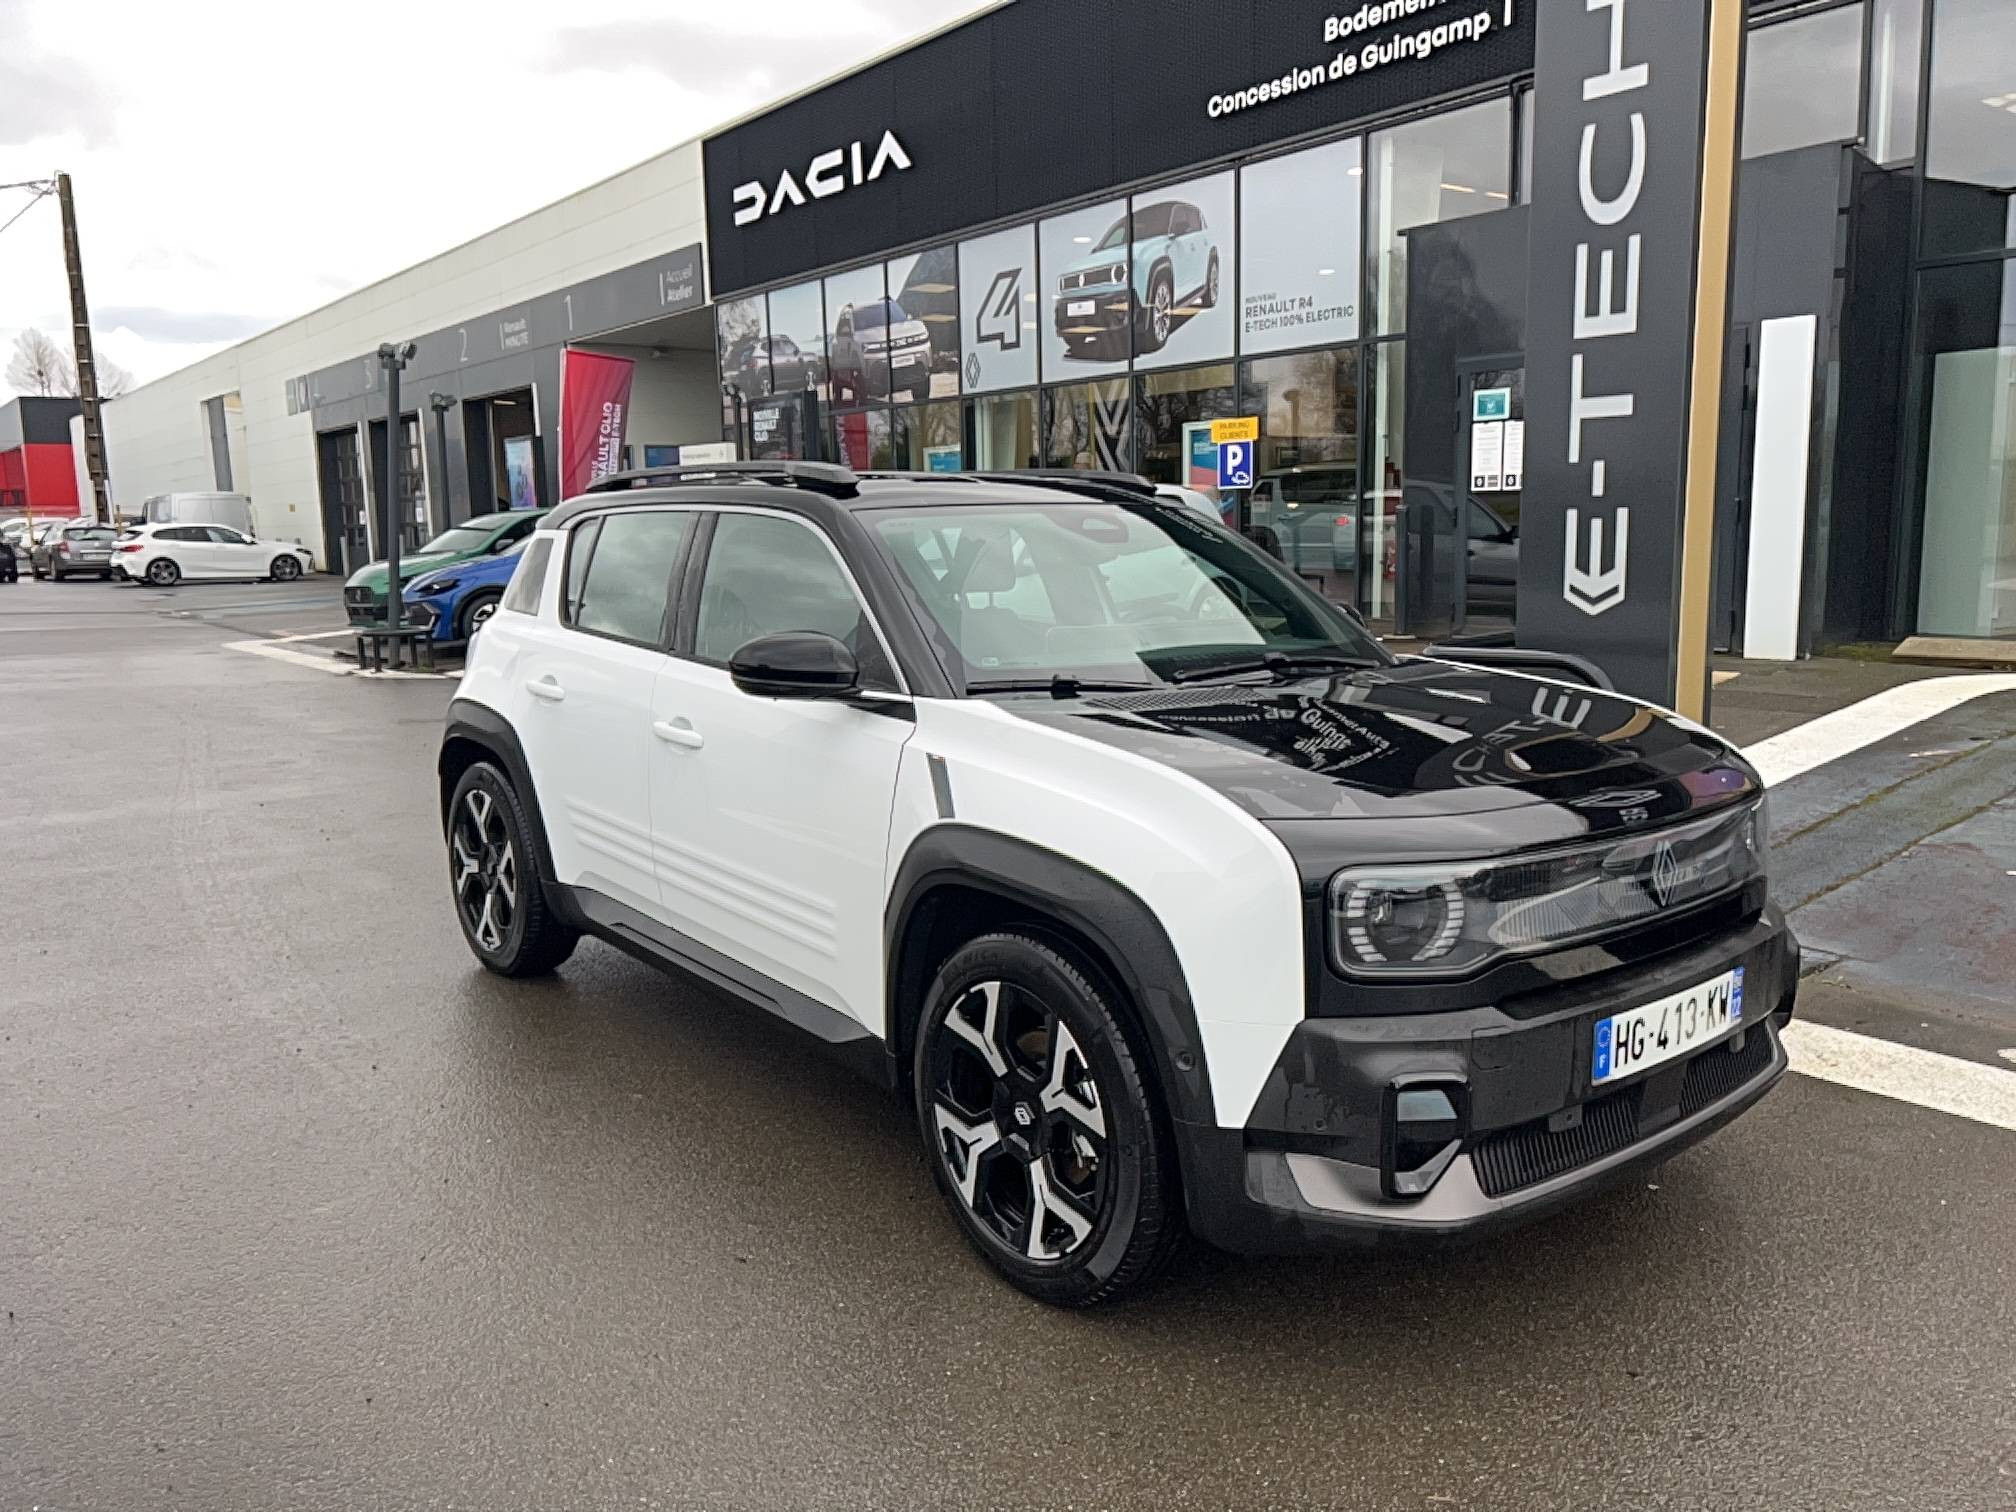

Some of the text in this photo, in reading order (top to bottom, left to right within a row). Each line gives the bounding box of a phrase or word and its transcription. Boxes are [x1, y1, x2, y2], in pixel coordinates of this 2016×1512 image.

[1208, 11, 1491, 118] Concession de Guingamp
[732, 129, 912, 226] DACIA
[564, 295, 573, 331] 1
[1245, 296, 1313, 318] RENAULT R4
[1245, 305, 1354, 333] E-TECH 100% ELECTRIC
[1563, 0, 1650, 616] E-TECH
[459, 328, 468, 362] 2
[1227, 444, 1243, 476] P
[1615, 981, 1731, 1068] HG-413-KW
